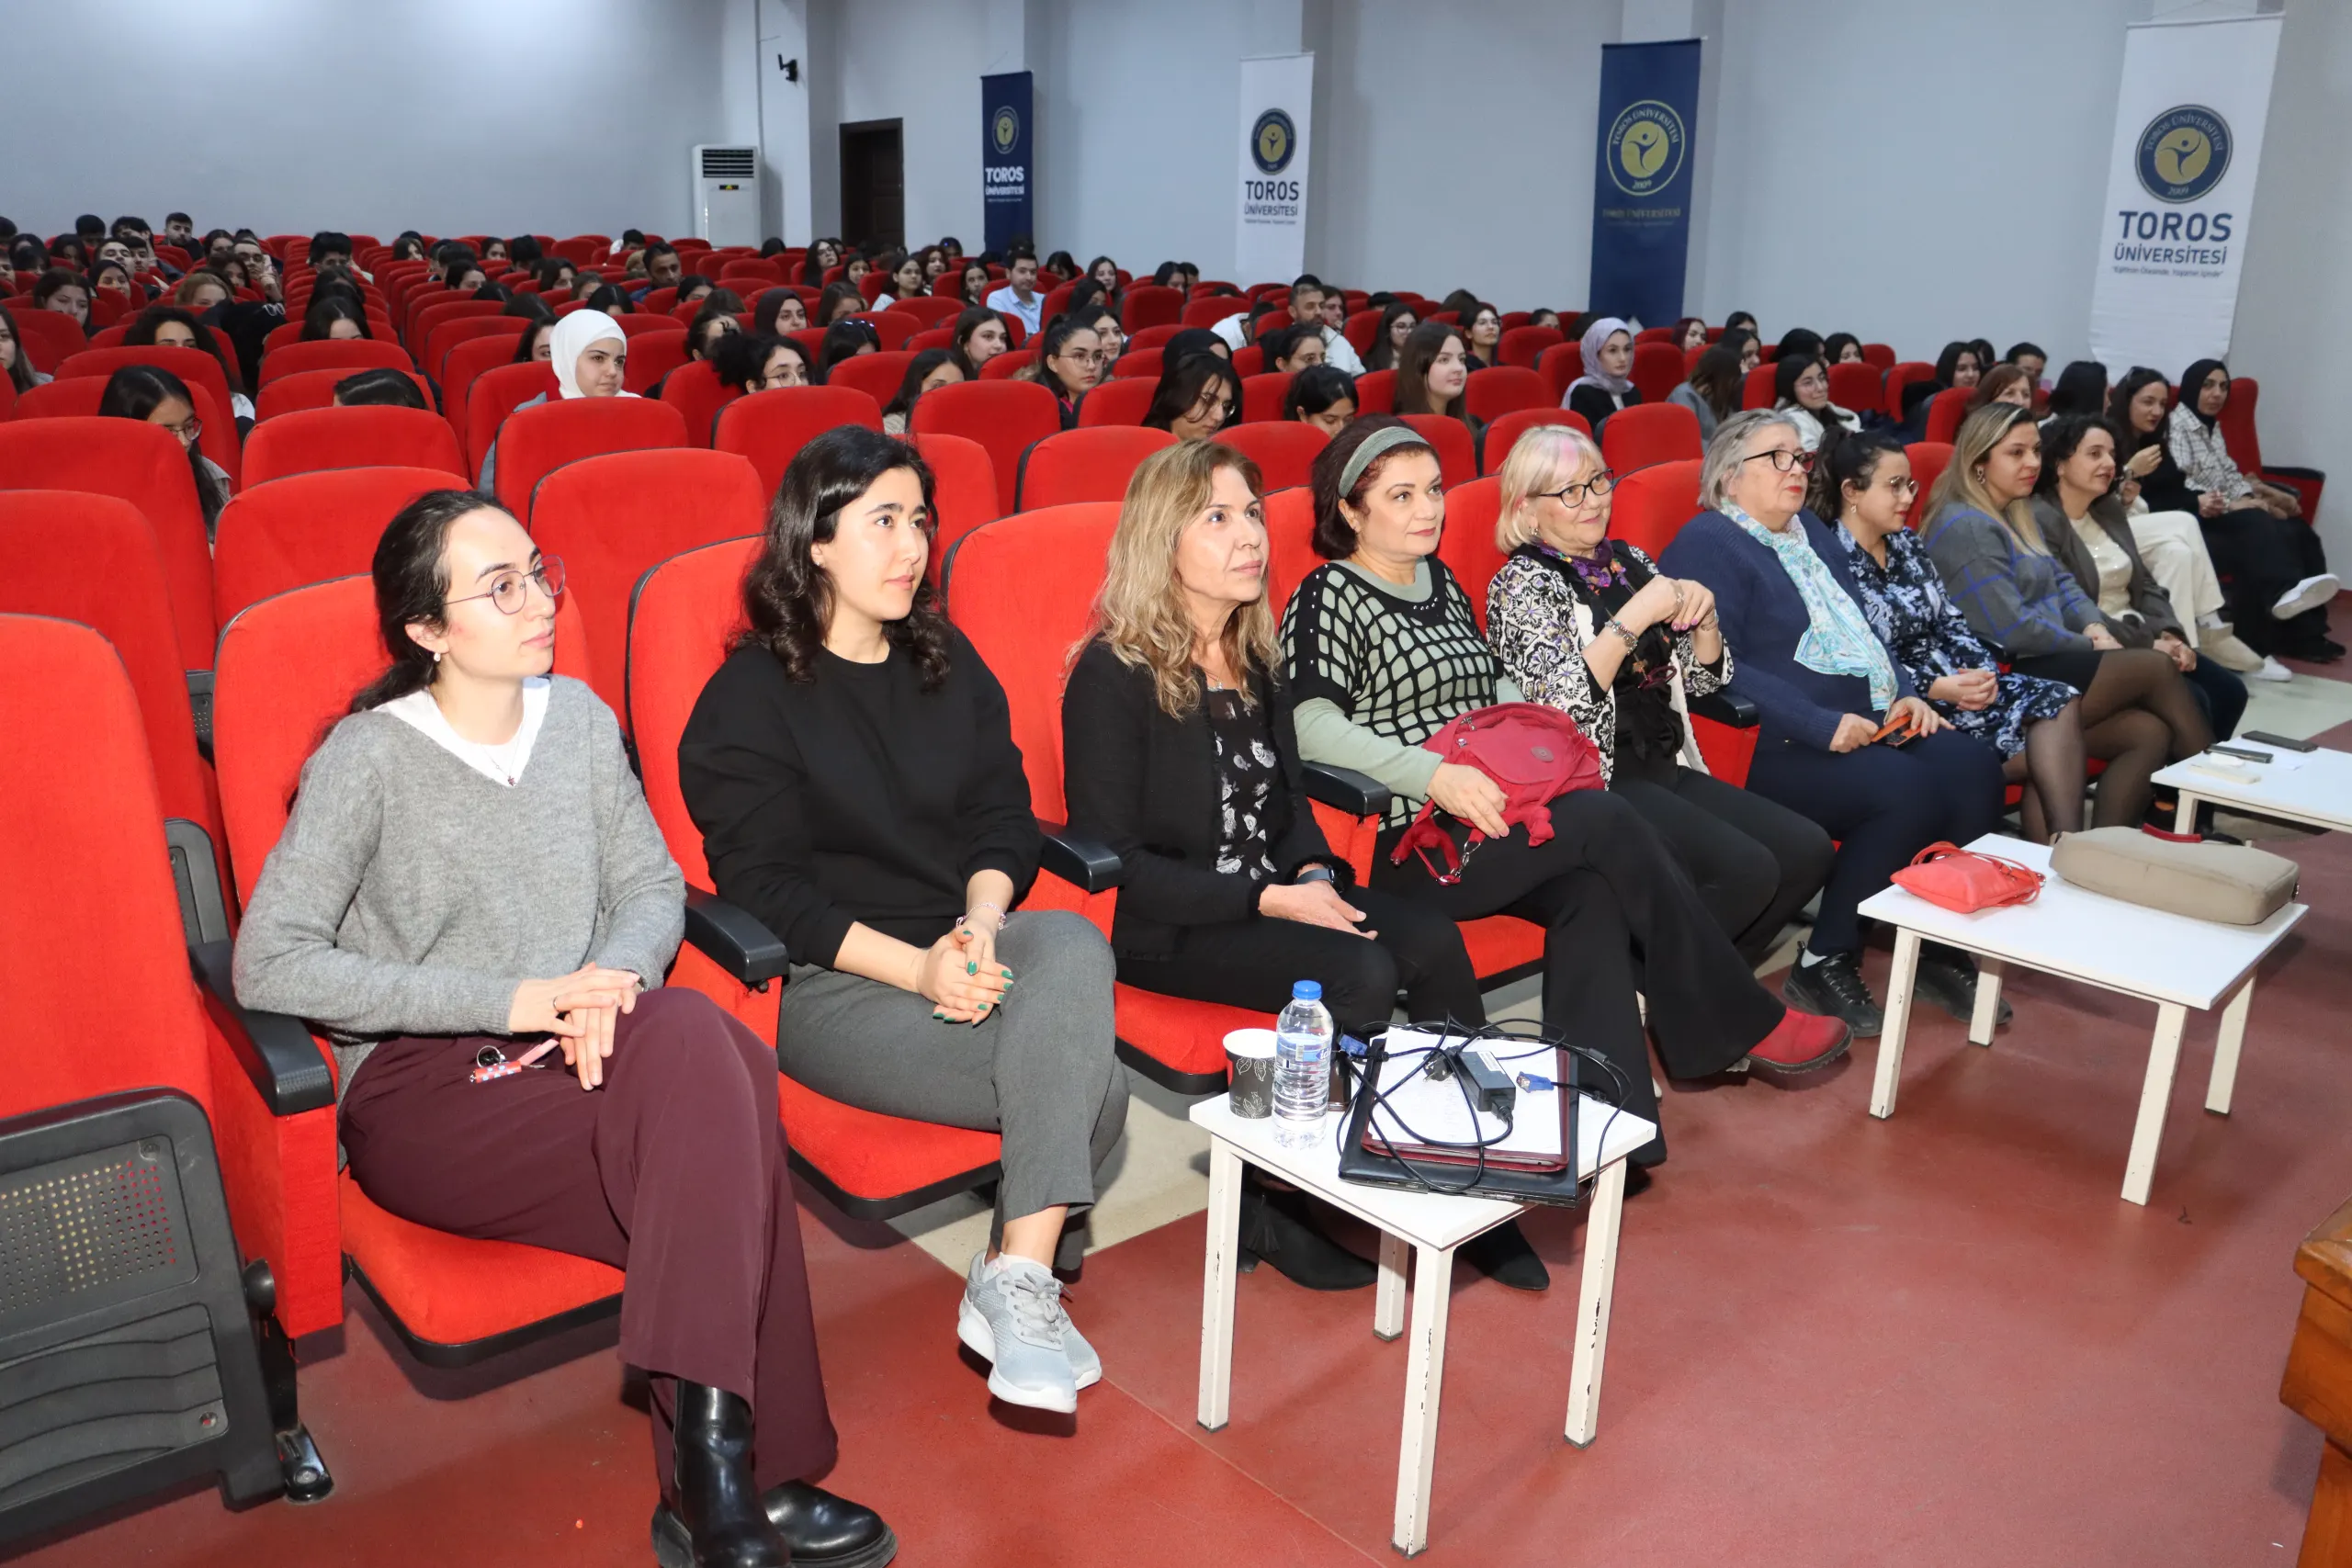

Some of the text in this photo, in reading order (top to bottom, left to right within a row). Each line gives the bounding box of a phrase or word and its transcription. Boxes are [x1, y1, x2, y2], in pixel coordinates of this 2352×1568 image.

[985, 166, 1024, 183] TOROS
[1245, 180, 1299, 201] TOROS
[1244, 201, 1298, 217] ÜNİVERSİTESİ
[2119, 210, 2233, 243] TOROS
[2114, 243, 2227, 265] ÜNİVERSİTESİ
